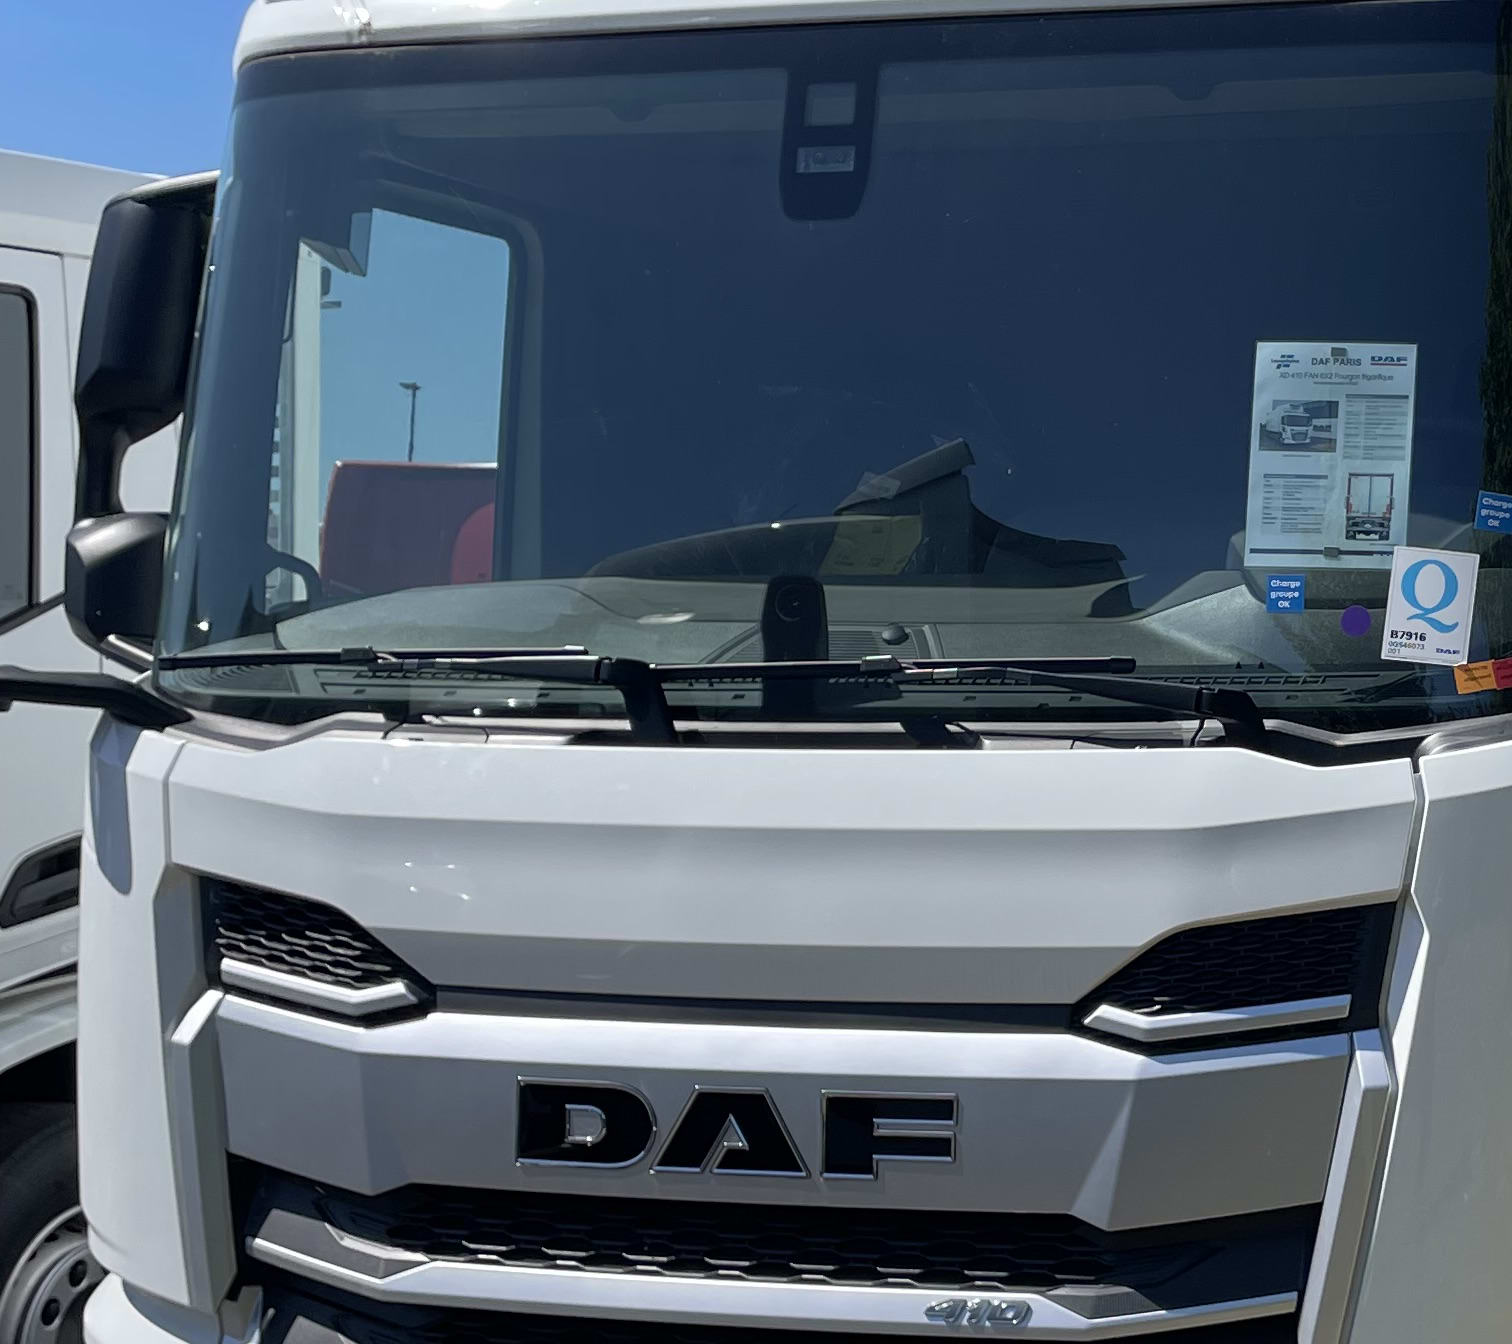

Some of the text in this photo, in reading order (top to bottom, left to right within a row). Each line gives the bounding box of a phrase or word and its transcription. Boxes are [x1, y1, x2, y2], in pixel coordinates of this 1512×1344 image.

[1311, 357, 1331, 366] DAF
[1333, 357, 1362, 367] PARIS
[1370, 355, 1408, 363] DAF
[1482, 497, 1512, 509] Charge
[1480, 508, 1510, 519] groupe
[1270, 579, 1301, 589] Charge
[1270, 591, 1300, 599] groupe
[1401, 559, 1459, 633] Q
[1277, 600, 1290, 608] OK
[1390, 629, 1427, 642] B7916
[516, 1075, 959, 1180] DAF
[924, 1297, 1033, 1328] 410
